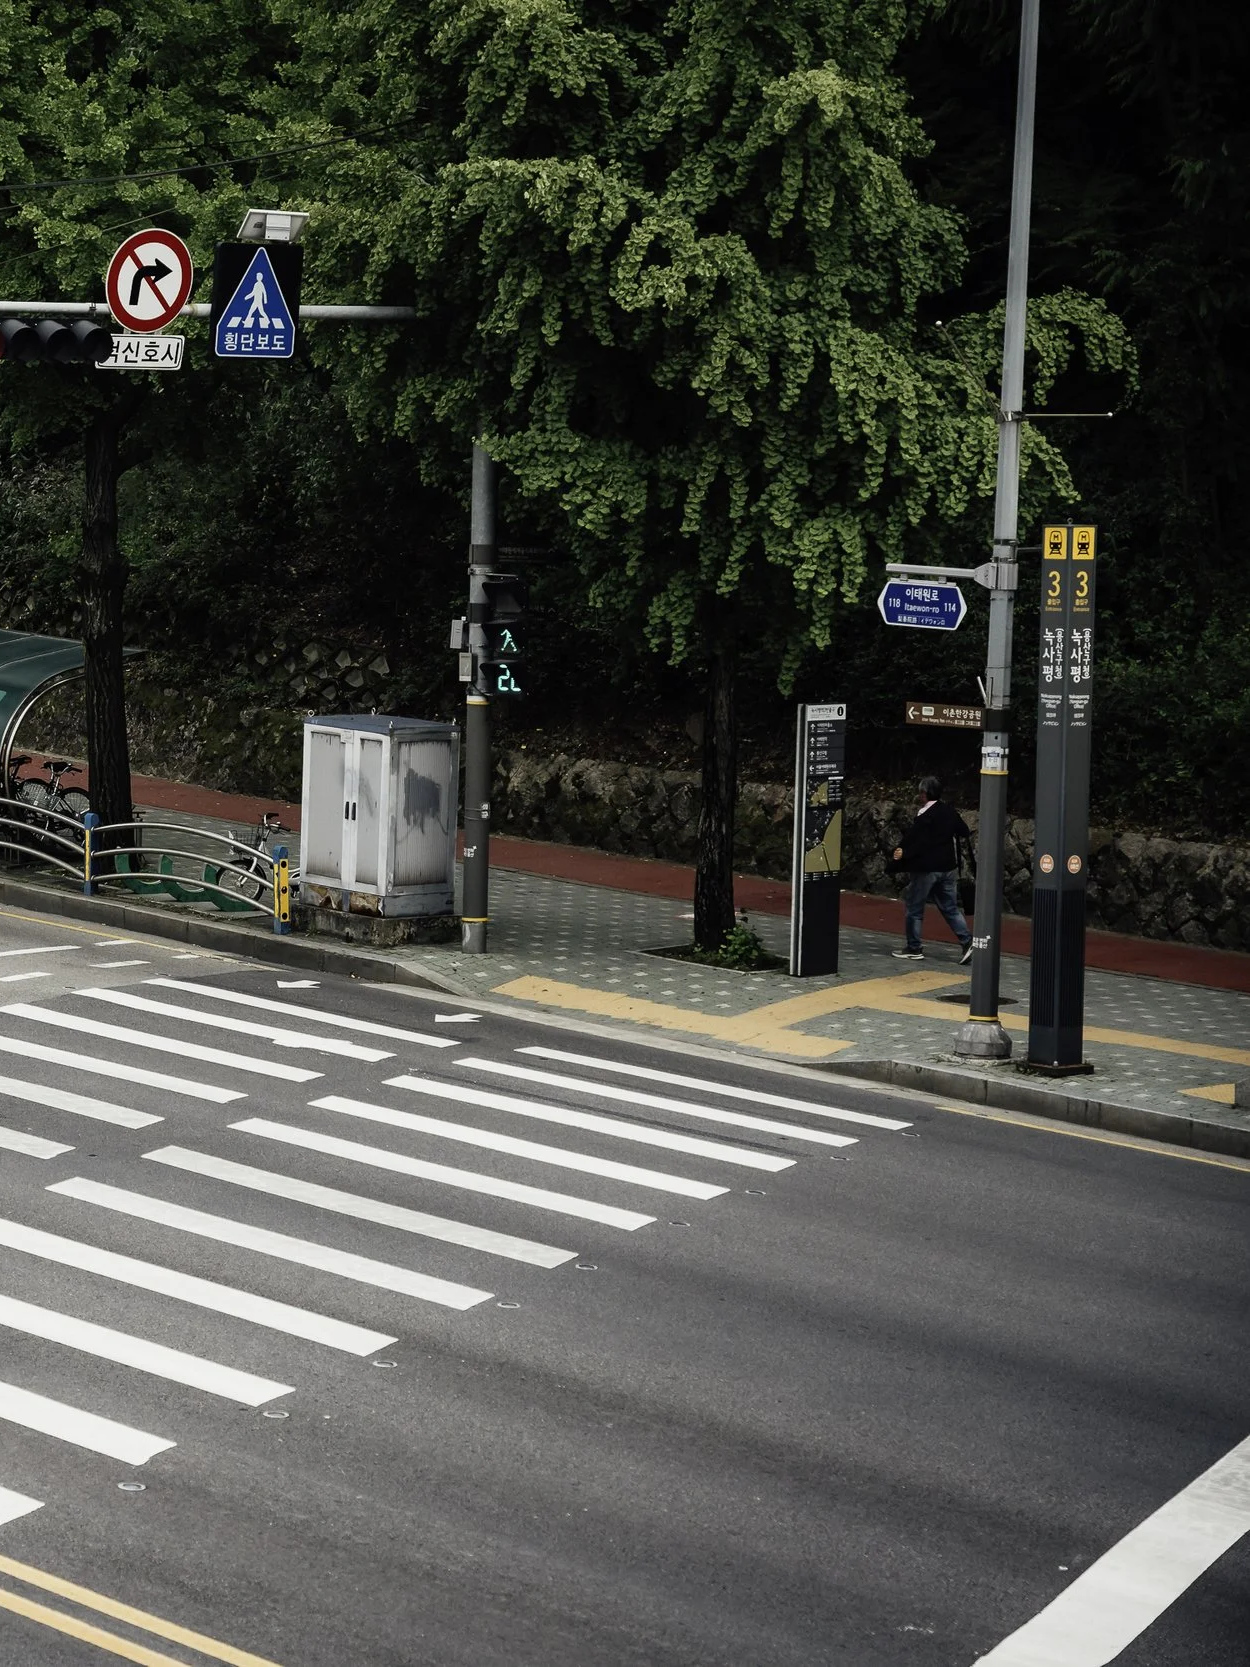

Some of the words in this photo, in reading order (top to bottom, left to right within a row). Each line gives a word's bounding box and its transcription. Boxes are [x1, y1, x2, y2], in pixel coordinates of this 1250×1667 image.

[223, 332, 286, 352] 횡단보도
[905, 587, 940, 602] 이태원로
[1047, 570, 1061, 597] 3
[1075, 570, 1089, 597] 3
[888, 598, 901, 608] 118
[904, 602, 940, 614] Itaewon-ro
[944, 602, 957, 613] 114
[1042, 628, 1055, 683] 녹사평
[1054, 628, 1065, 679] (용산구청)
[1070, 628, 1083, 683] 녹사평
[1081, 628, 1092, 679] (용산구청)
[942, 708, 982, 720] 이촌한강공원
